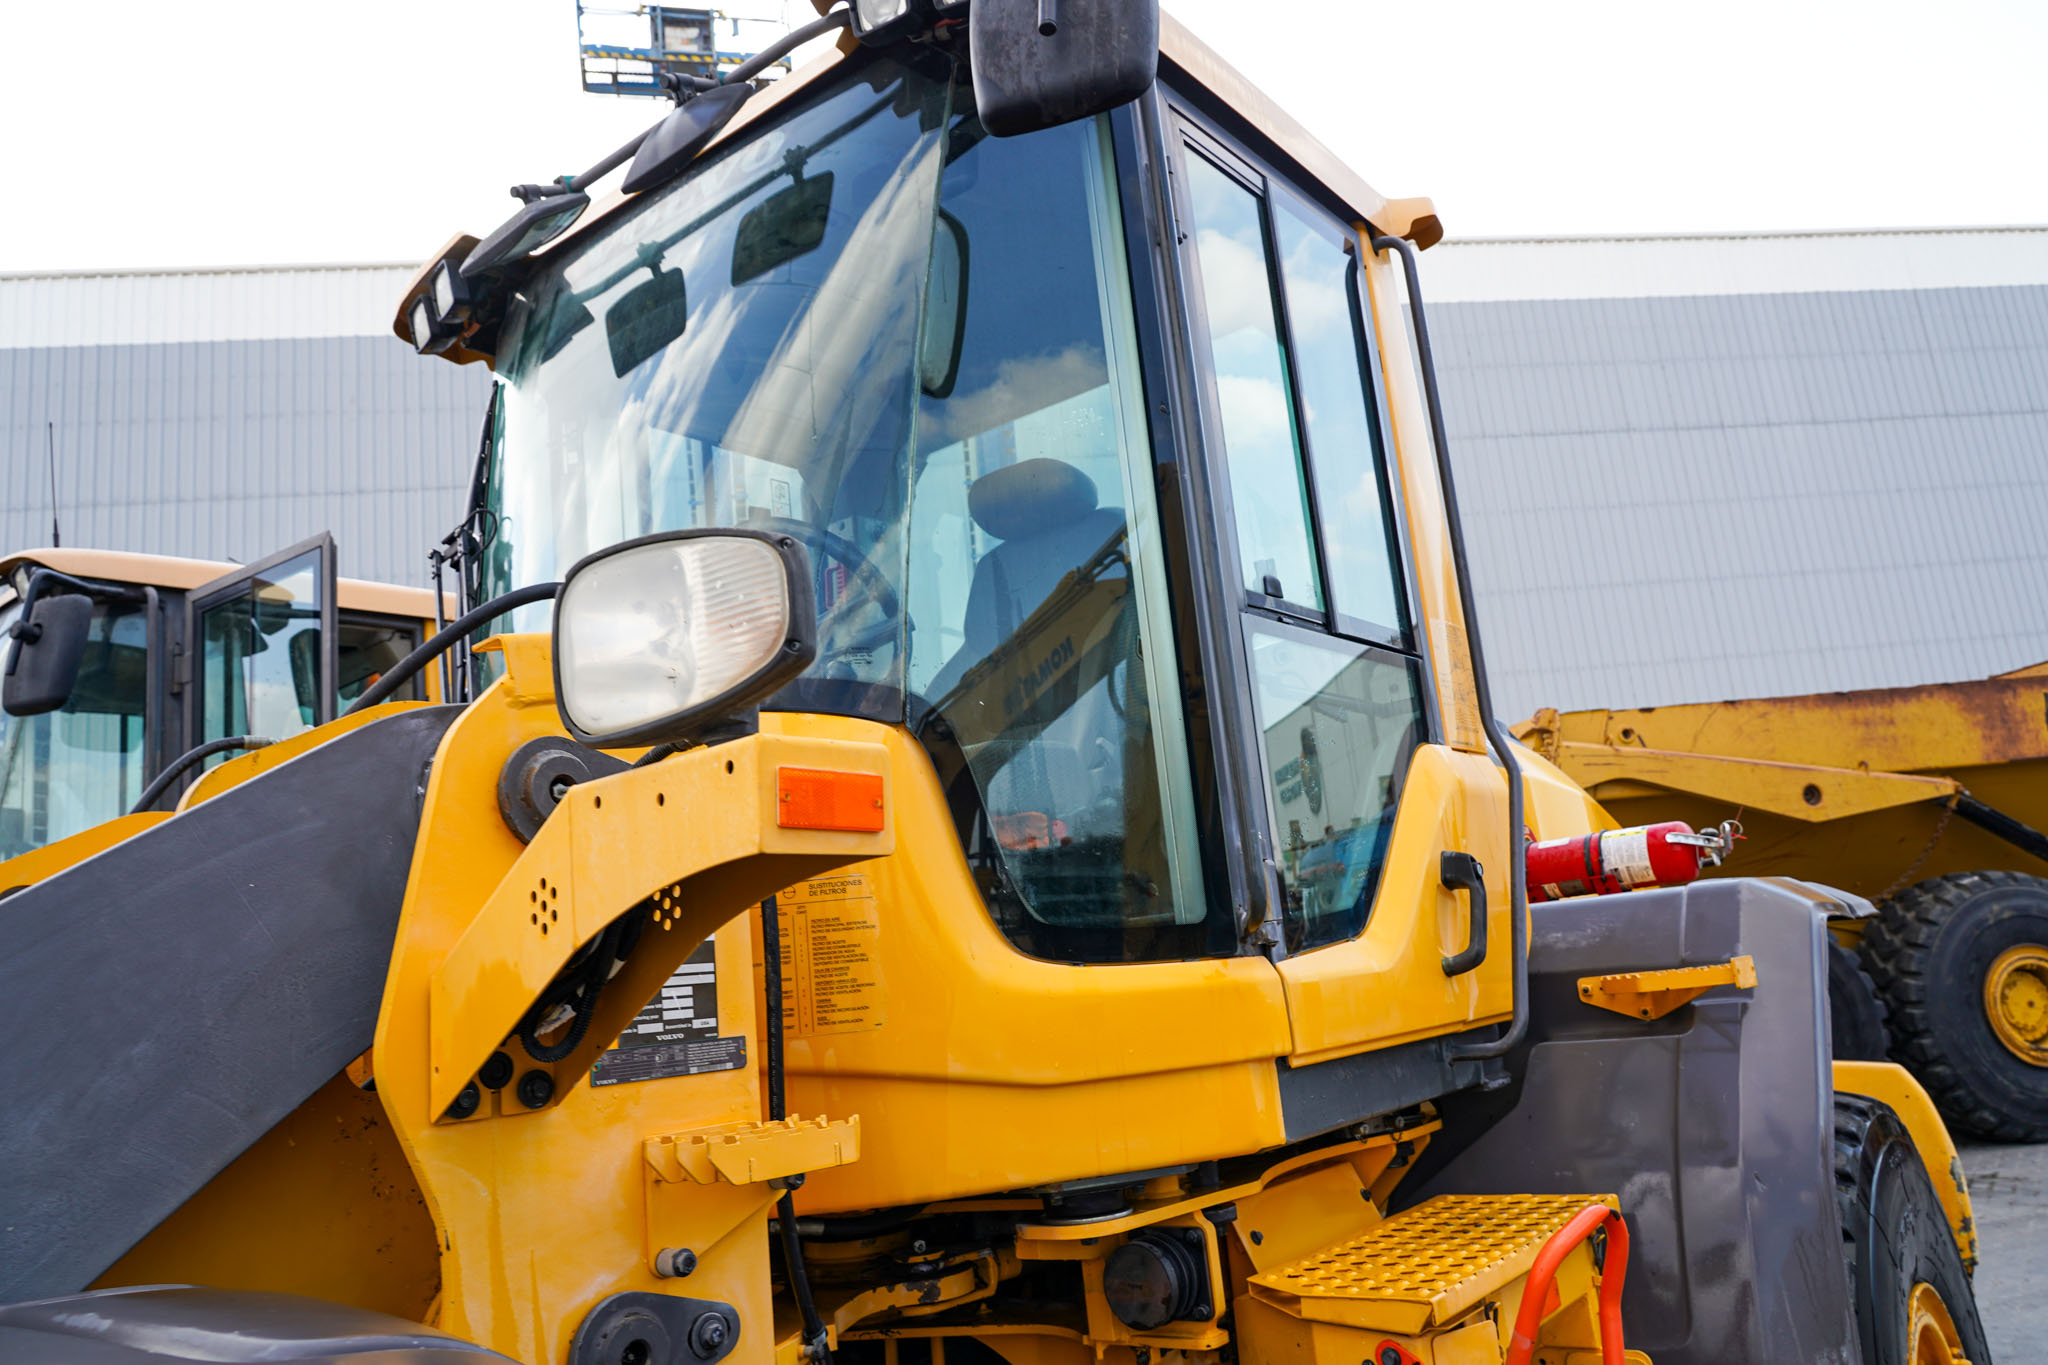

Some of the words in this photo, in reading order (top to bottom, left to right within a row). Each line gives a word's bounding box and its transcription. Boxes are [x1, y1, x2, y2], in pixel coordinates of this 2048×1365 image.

[808, 879, 863, 890] SUSTITUCIONES
[820, 887, 847, 896] FILTROS
[655, 1032, 685, 1041] VOLVO
